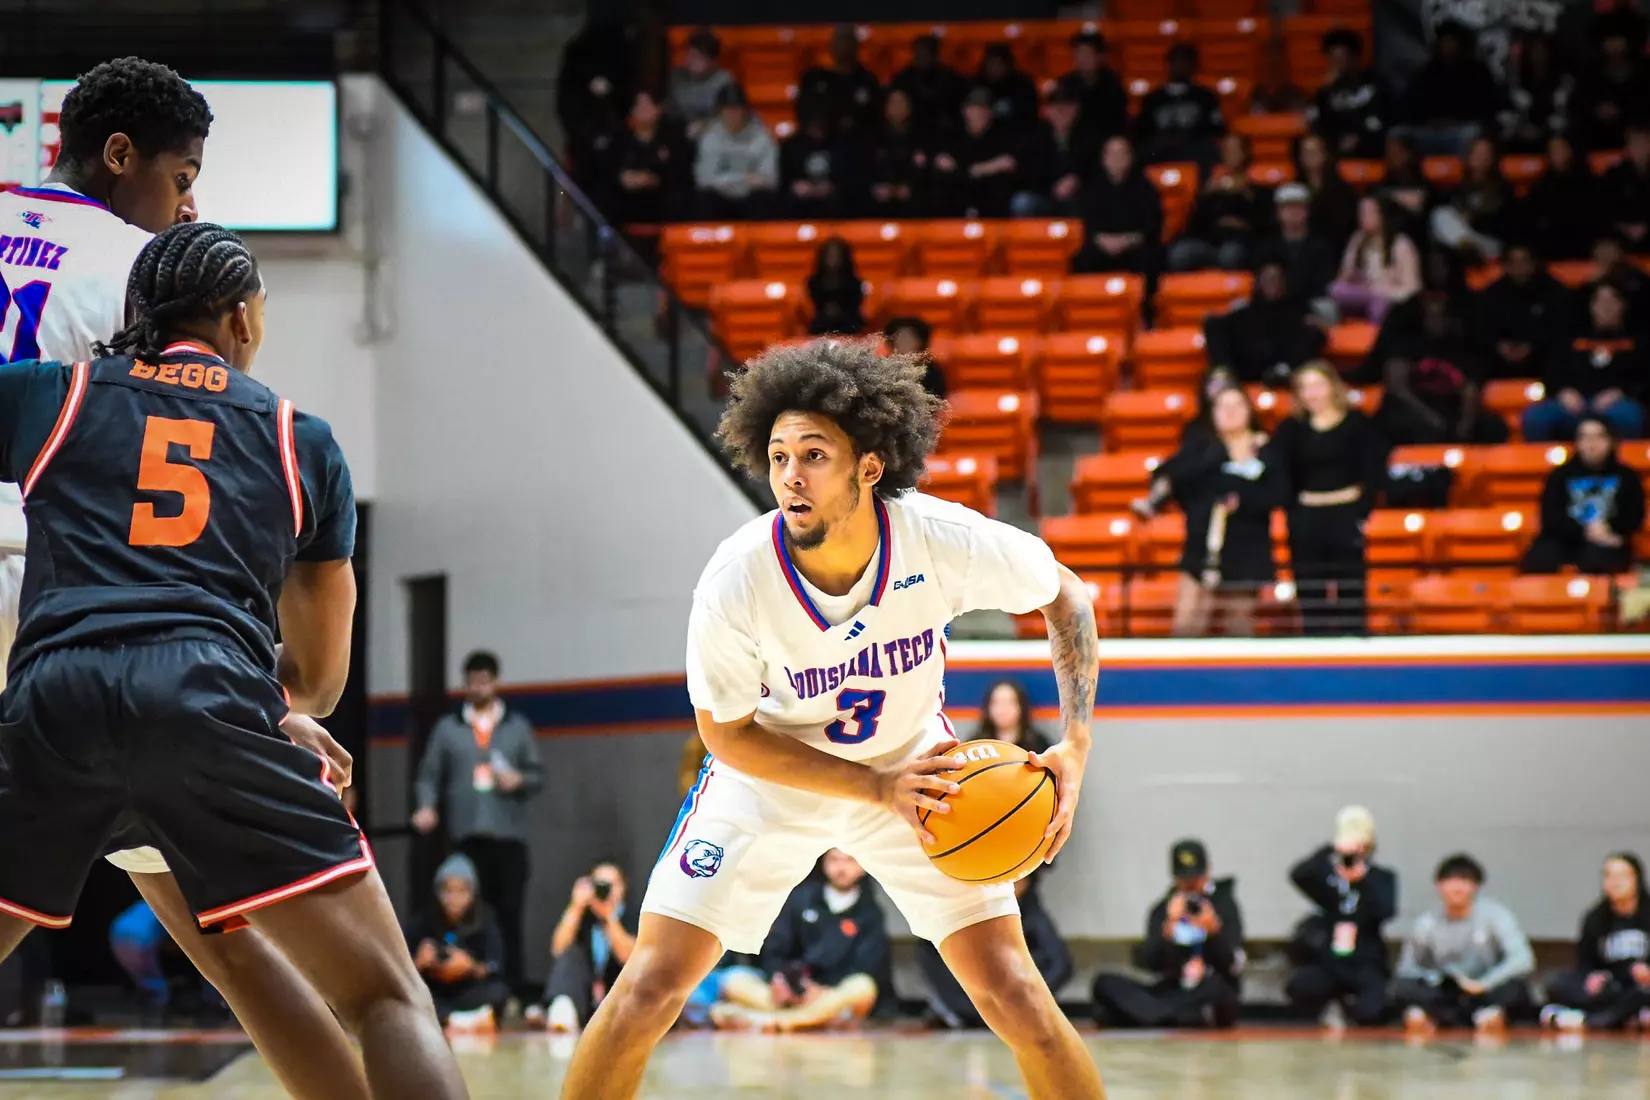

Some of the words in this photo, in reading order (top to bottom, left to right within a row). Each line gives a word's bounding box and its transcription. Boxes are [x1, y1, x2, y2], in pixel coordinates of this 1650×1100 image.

[129, 359, 229, 393] BEGG
[128, 415, 216, 547] 5
[883, 628, 935, 678] TECH
[824, 687, 887, 745] 3
